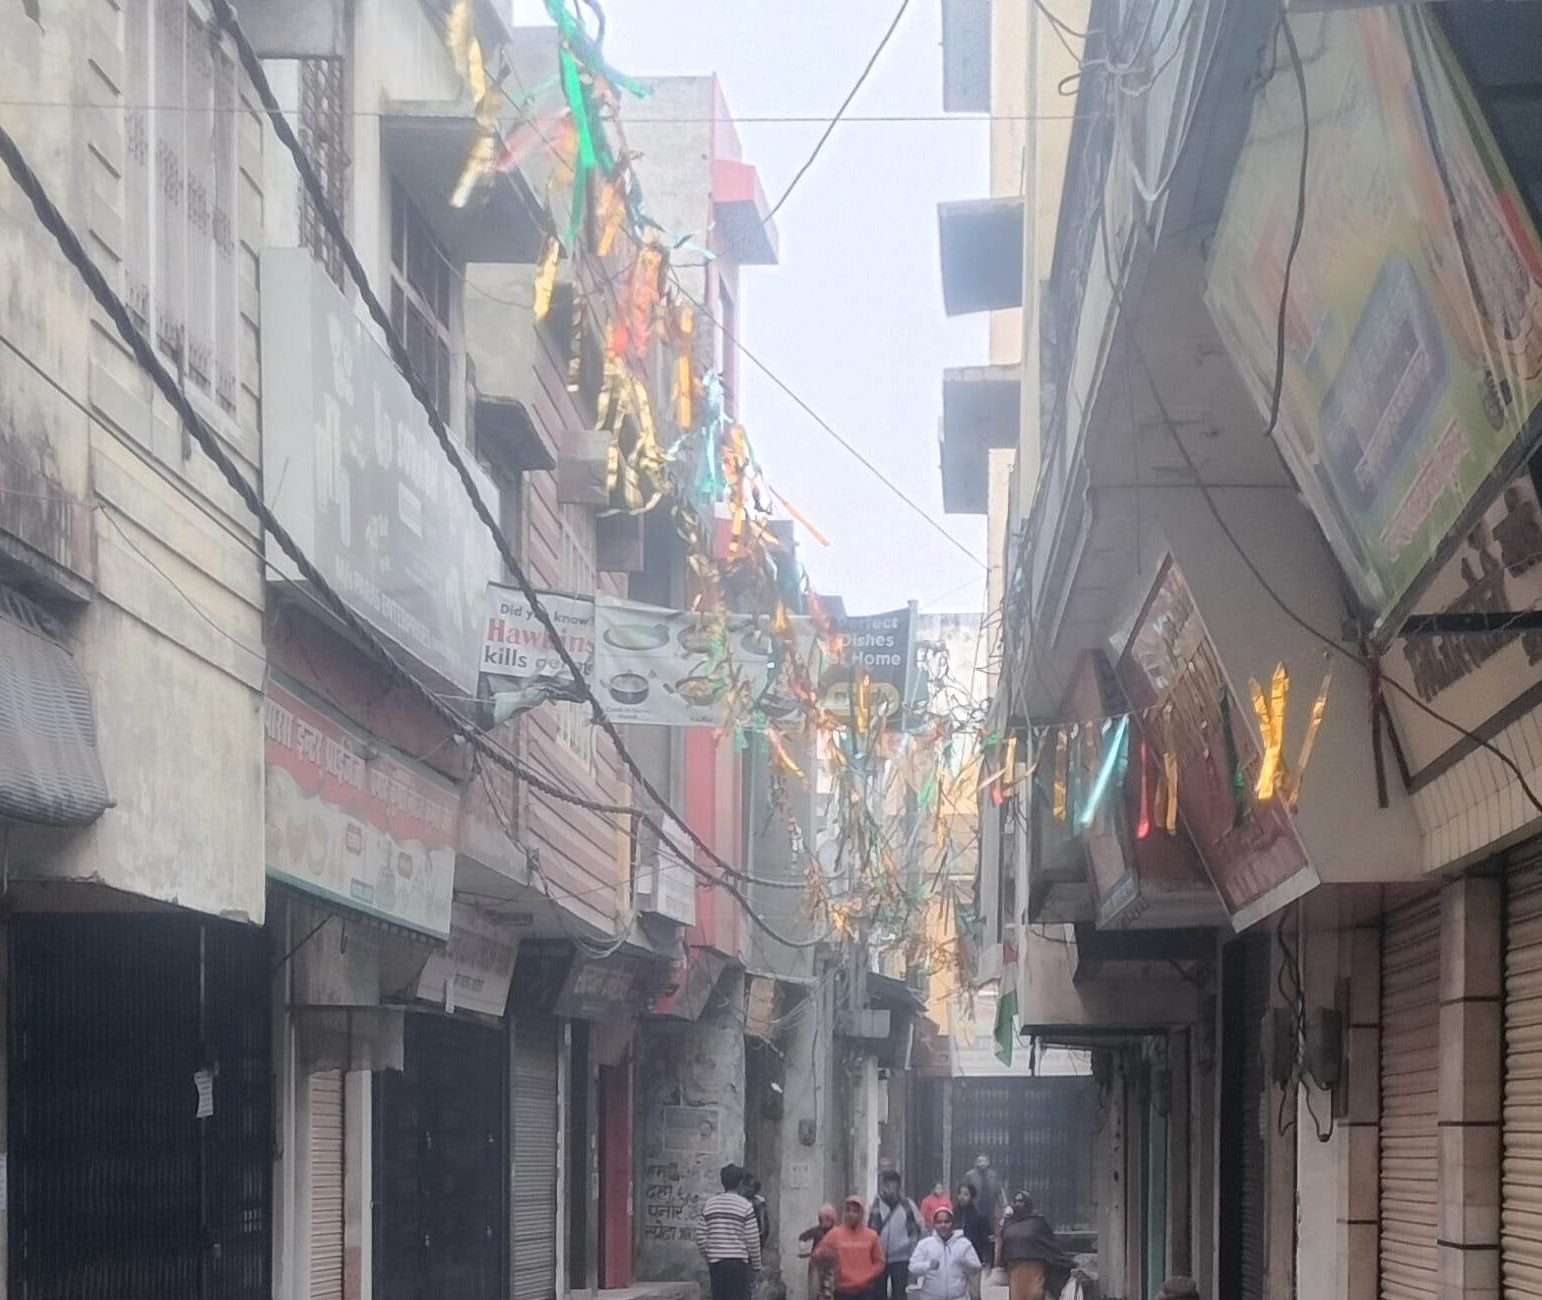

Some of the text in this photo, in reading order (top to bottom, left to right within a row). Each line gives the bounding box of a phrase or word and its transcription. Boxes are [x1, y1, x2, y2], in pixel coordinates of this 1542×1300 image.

[500, 604, 522, 617] Did
[554, 611, 595, 626] know?
[842, 634, 895, 648] Dishes
[484, 645, 528, 668] kills
[852, 652, 901, 666] Home
